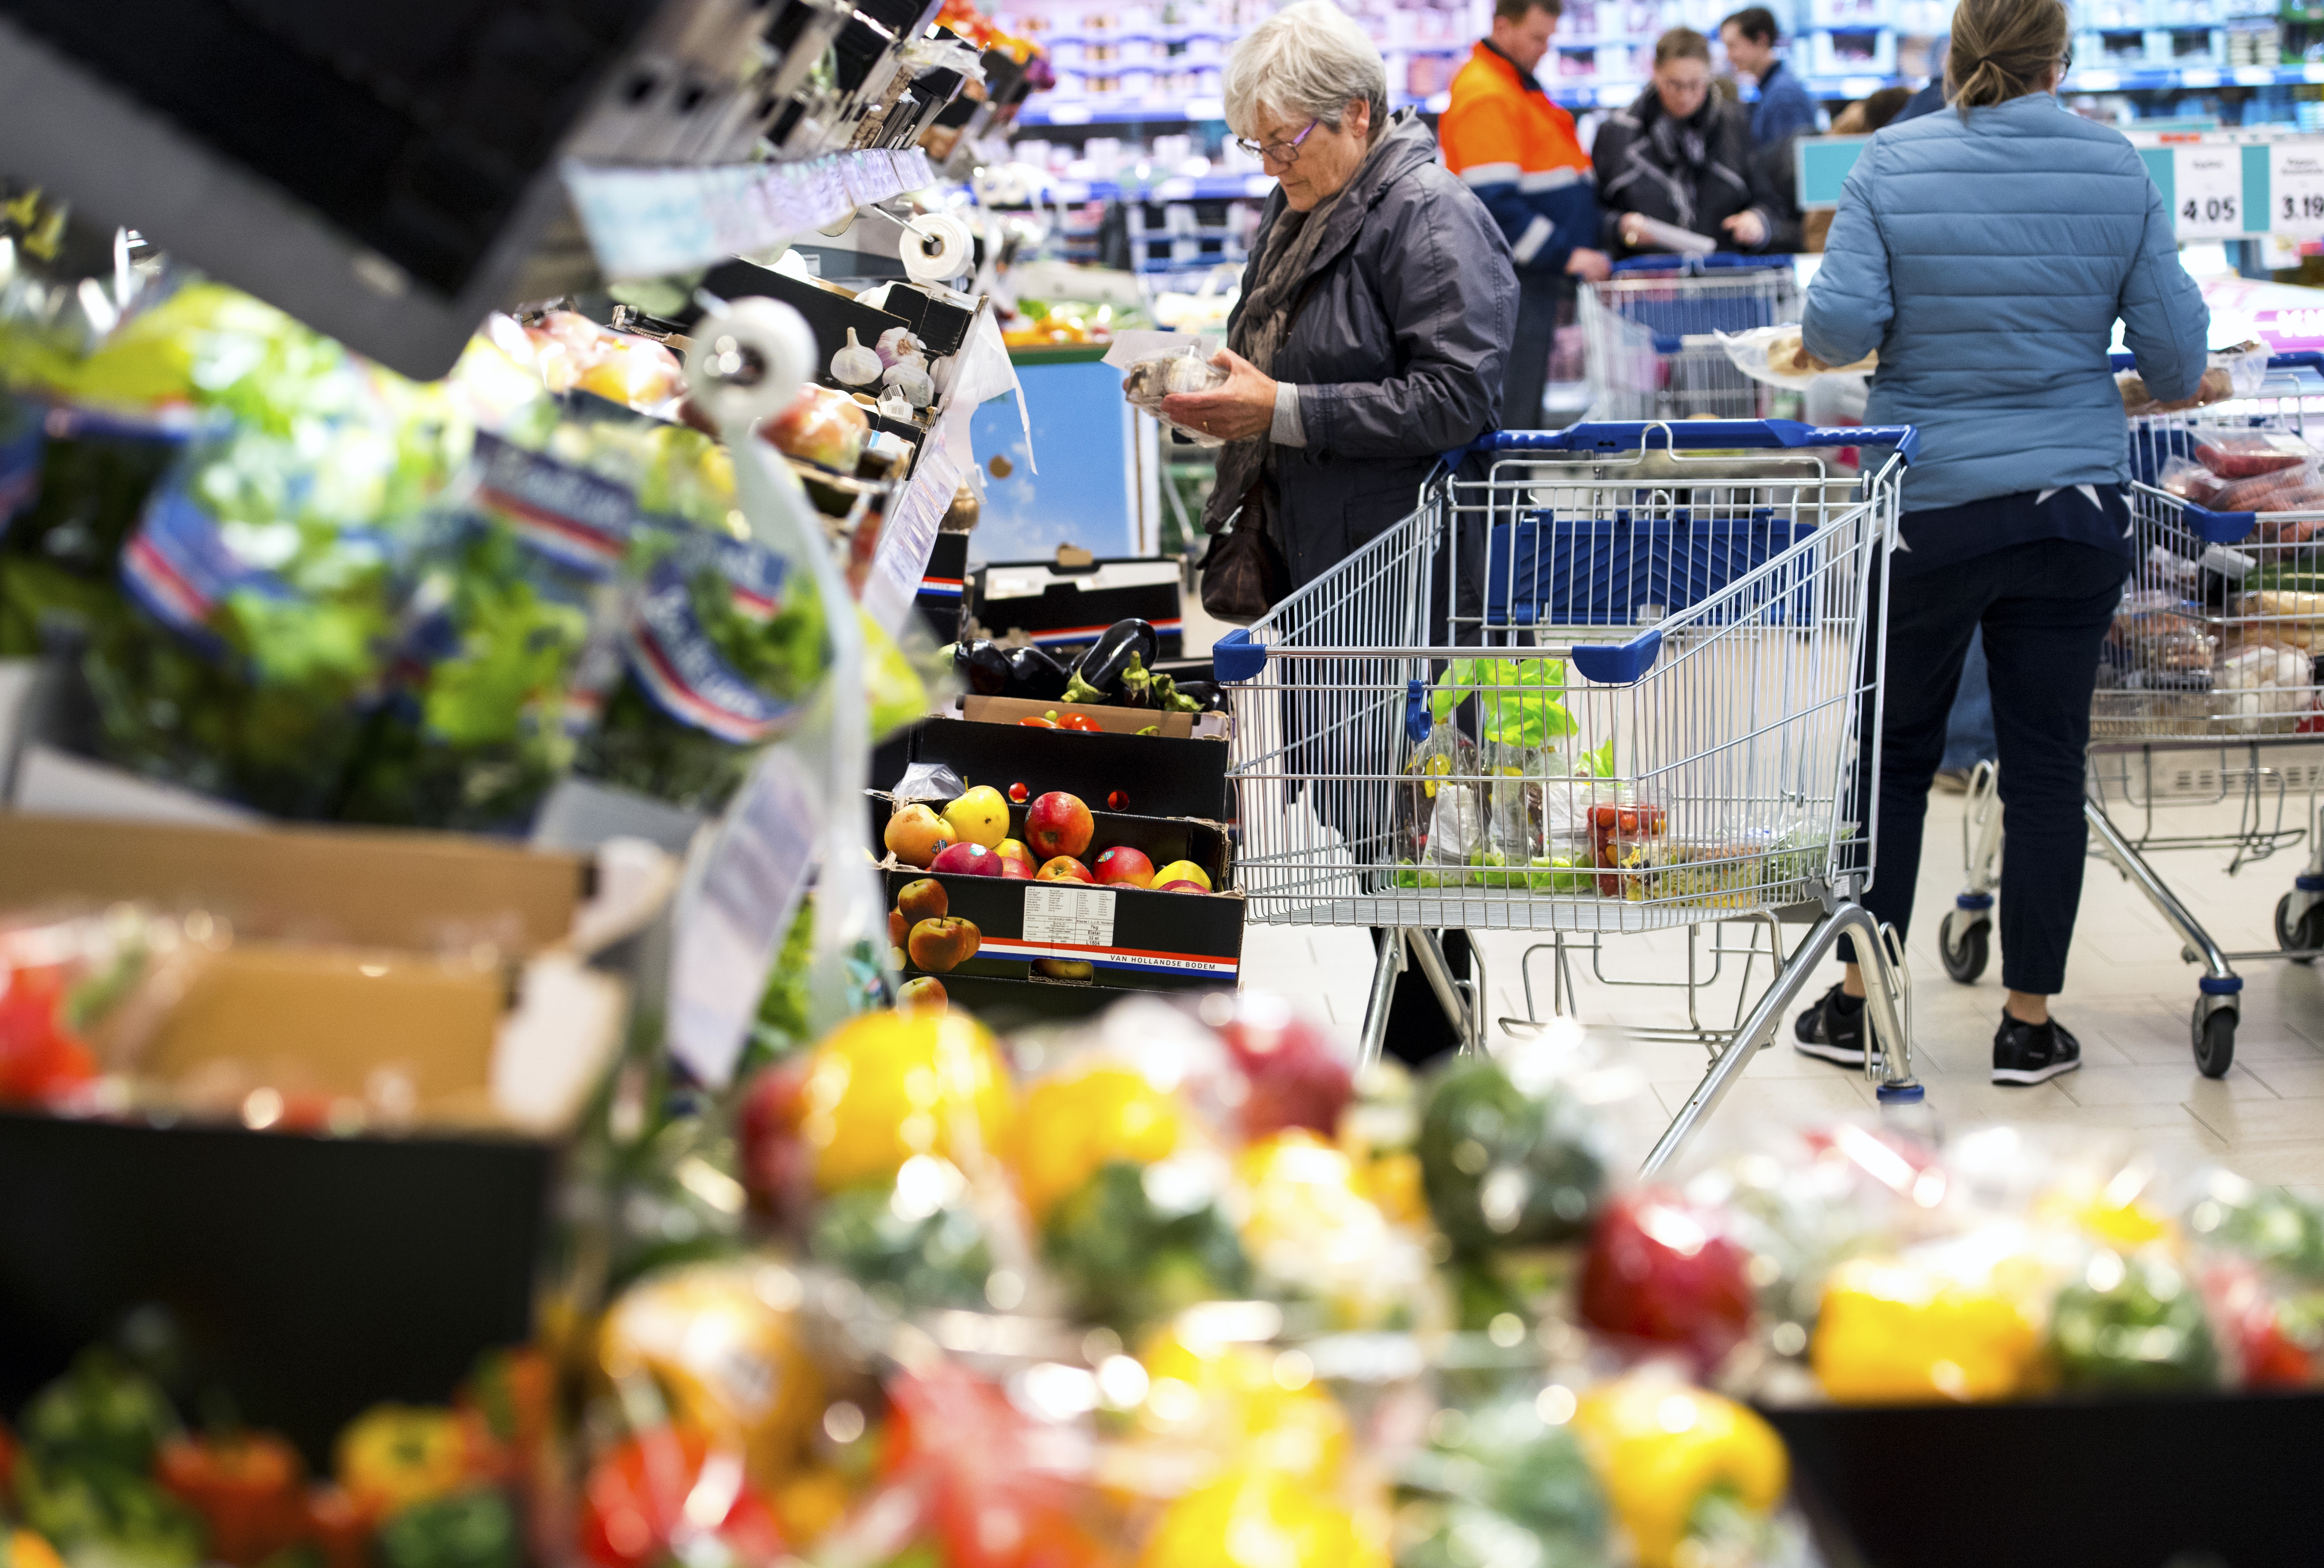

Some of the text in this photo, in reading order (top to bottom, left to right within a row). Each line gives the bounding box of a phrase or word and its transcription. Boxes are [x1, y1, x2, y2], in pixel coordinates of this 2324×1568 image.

[2183, 197, 2236, 221] 4.05
[2283, 196, 2324, 220] 3.19
[1131, 957, 1181, 967] HOLLANDSE
[1186, 962, 1215, 970] BODEM
